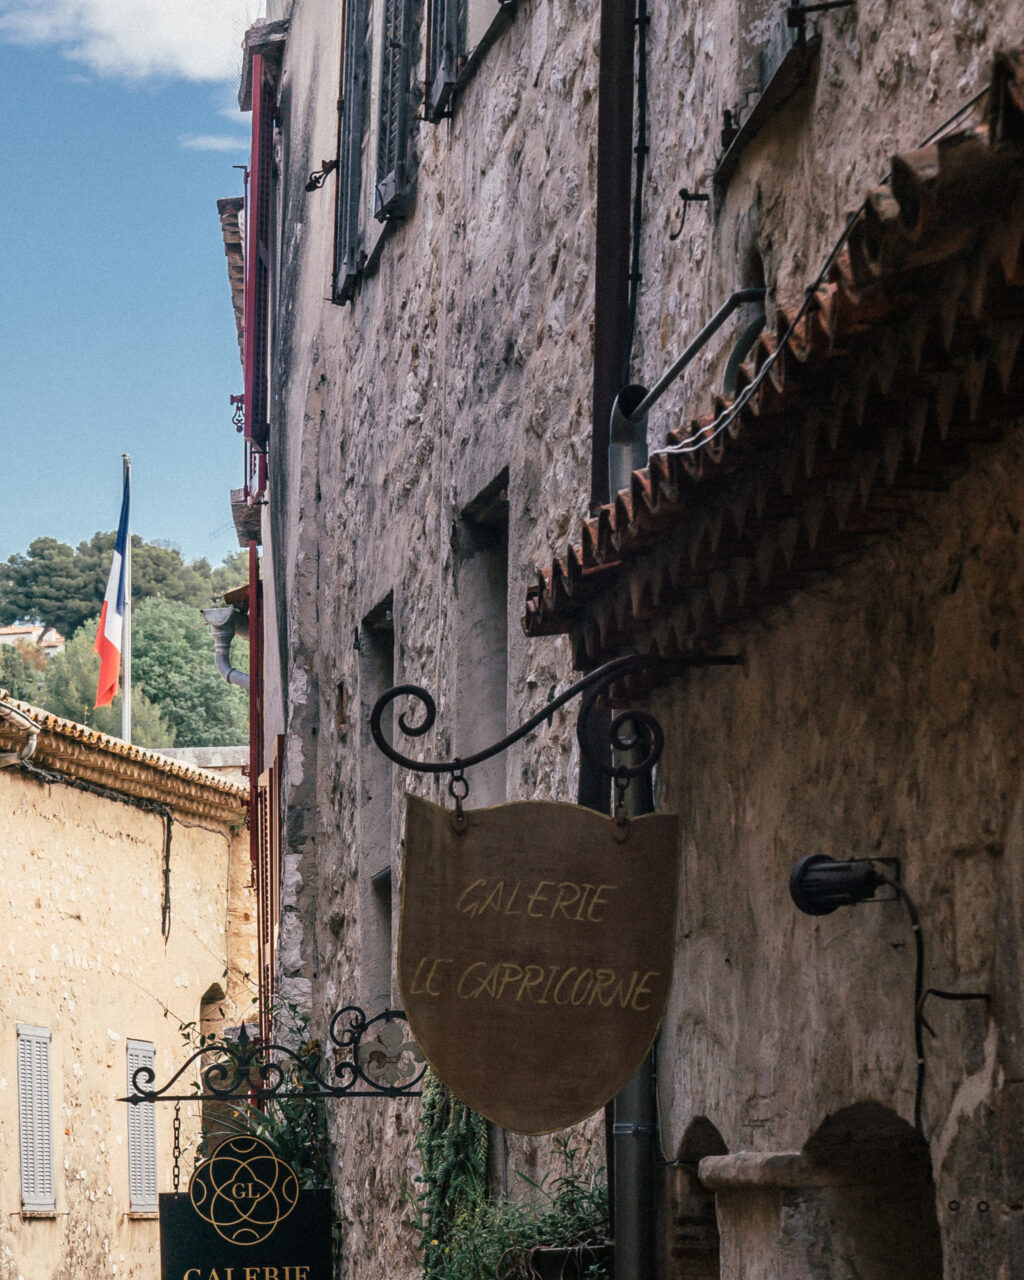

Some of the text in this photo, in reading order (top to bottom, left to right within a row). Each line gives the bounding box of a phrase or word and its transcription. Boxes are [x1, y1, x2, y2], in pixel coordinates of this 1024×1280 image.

[456, 878, 618, 923] GALERIE
[409, 956, 661, 1011] LE CAPRICORNE
[231, 1182, 261, 1200] GL
